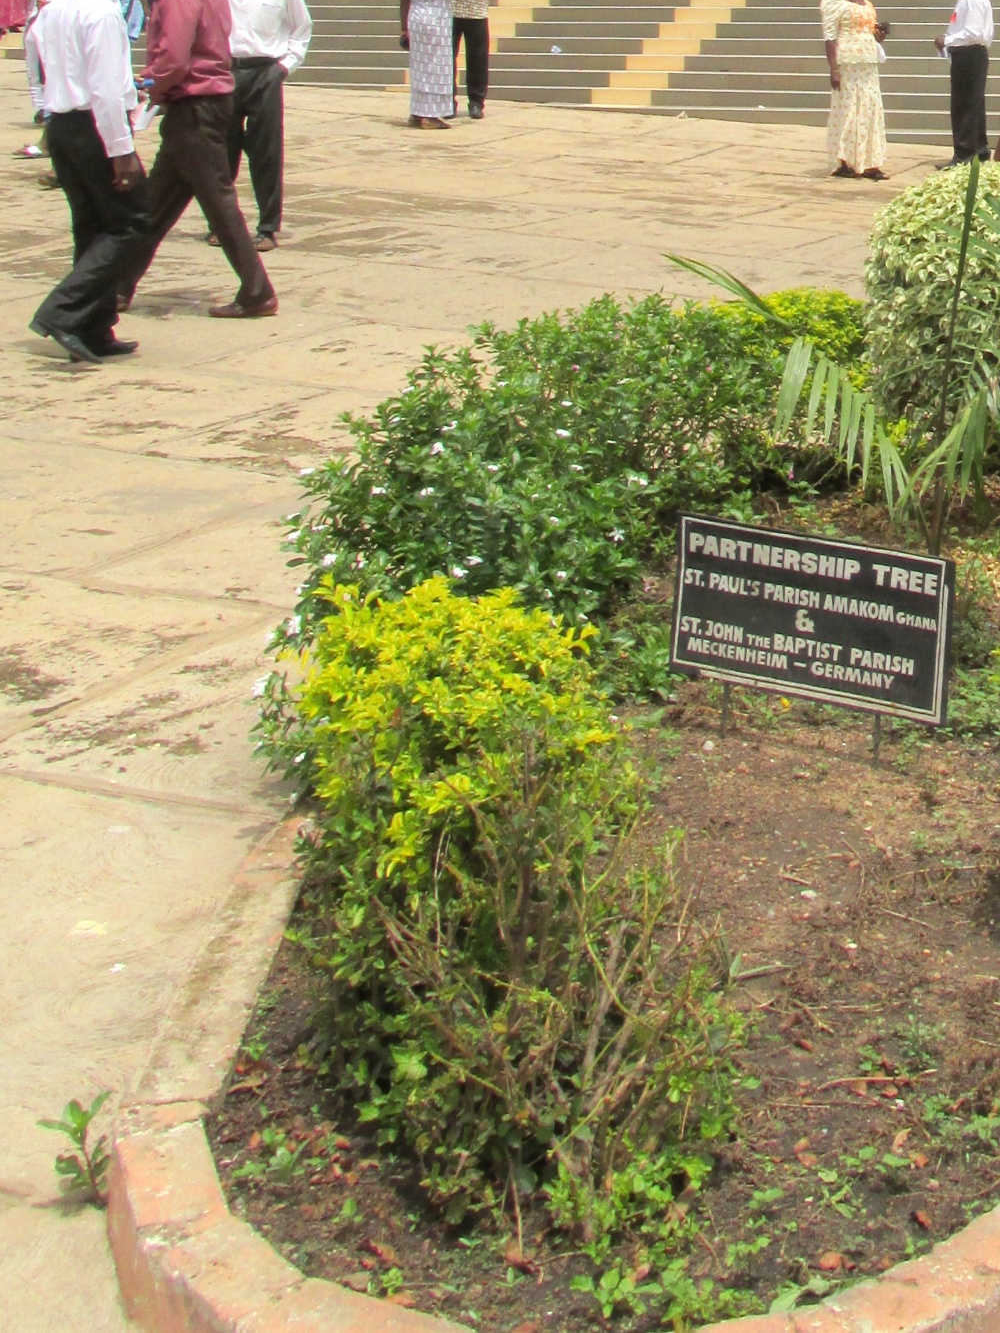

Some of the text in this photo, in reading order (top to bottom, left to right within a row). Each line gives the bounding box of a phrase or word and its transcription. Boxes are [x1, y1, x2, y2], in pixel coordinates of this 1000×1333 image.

[689, 532, 938, 596] PARTNERSHIP TREE
[684, 568, 937, 630] ST. PAUL'S PARISH AMAKOM GHANA
[795, 609, 814, 633] &
[680, 616, 915, 675] ST. JOHN THE BAPTIST PARISH
[687, 637, 787, 669] MECKENHEIM
[811, 662, 894, 689] GERMANY
